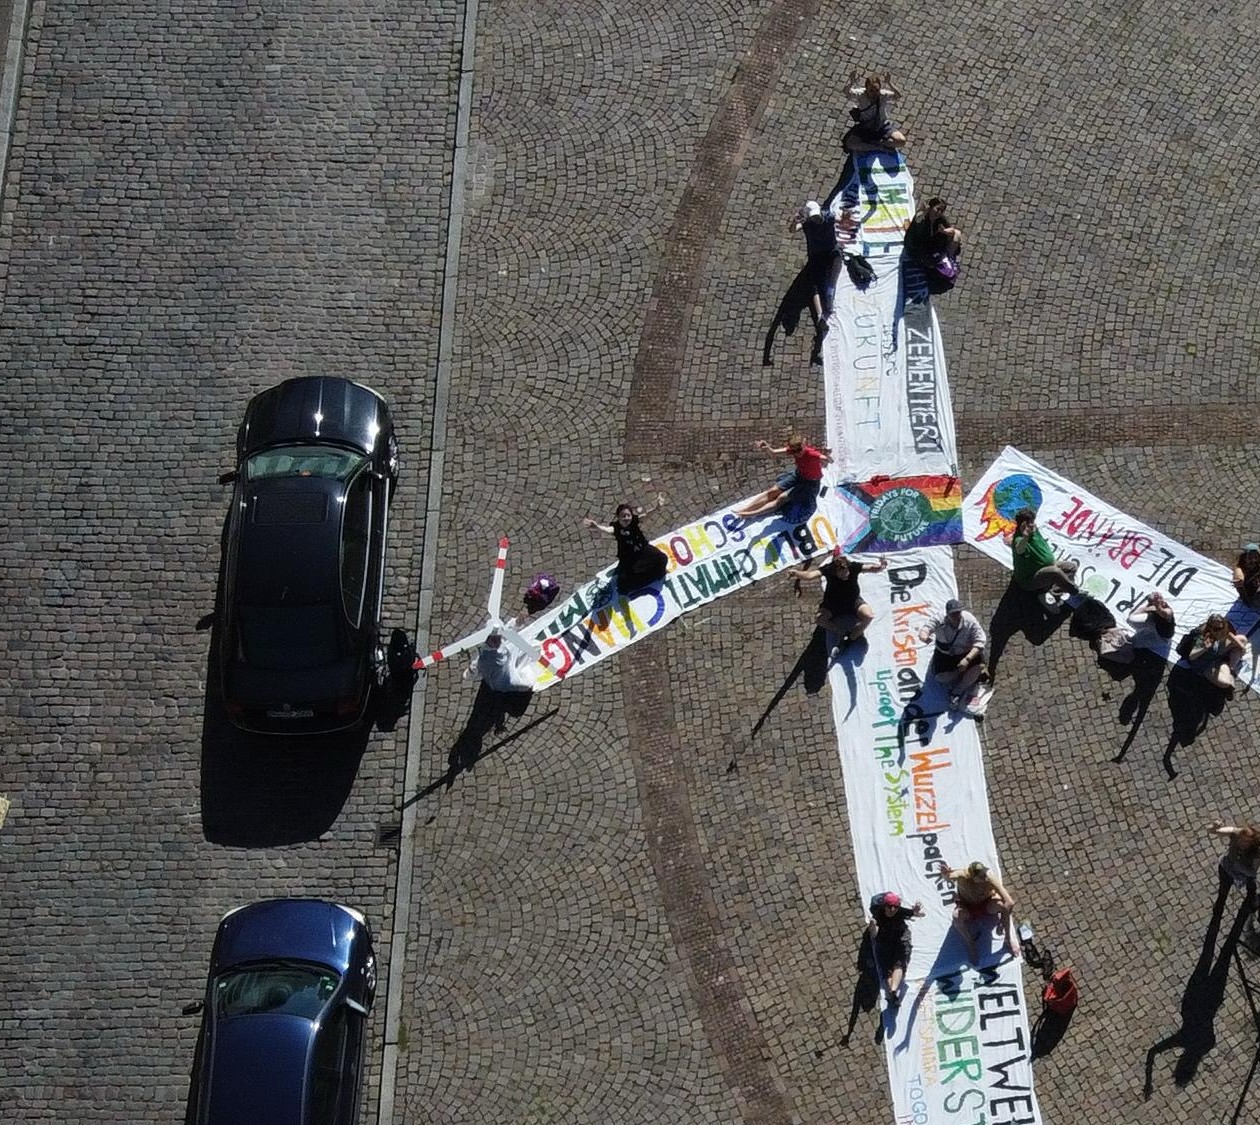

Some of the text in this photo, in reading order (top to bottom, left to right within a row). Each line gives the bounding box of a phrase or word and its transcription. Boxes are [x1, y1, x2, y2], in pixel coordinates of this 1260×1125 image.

[852, 294, 882, 430] ZUKUNFT
[906, 327, 941, 449] ZEMENTIERT
[870, 488, 920, 519] FRIDAYS FOR
[894, 519, 930, 542] FUTURE
[888, 563, 928, 604] Die
[1048, 495, 1199, 597] DIE BRÄNDE
[891, 602, 931, 669] Krisen
[868, 668, 911, 837] Uproot The System
[908, 747, 952, 833] Wurzel
[907, 1075, 928, 1125] TOGO
